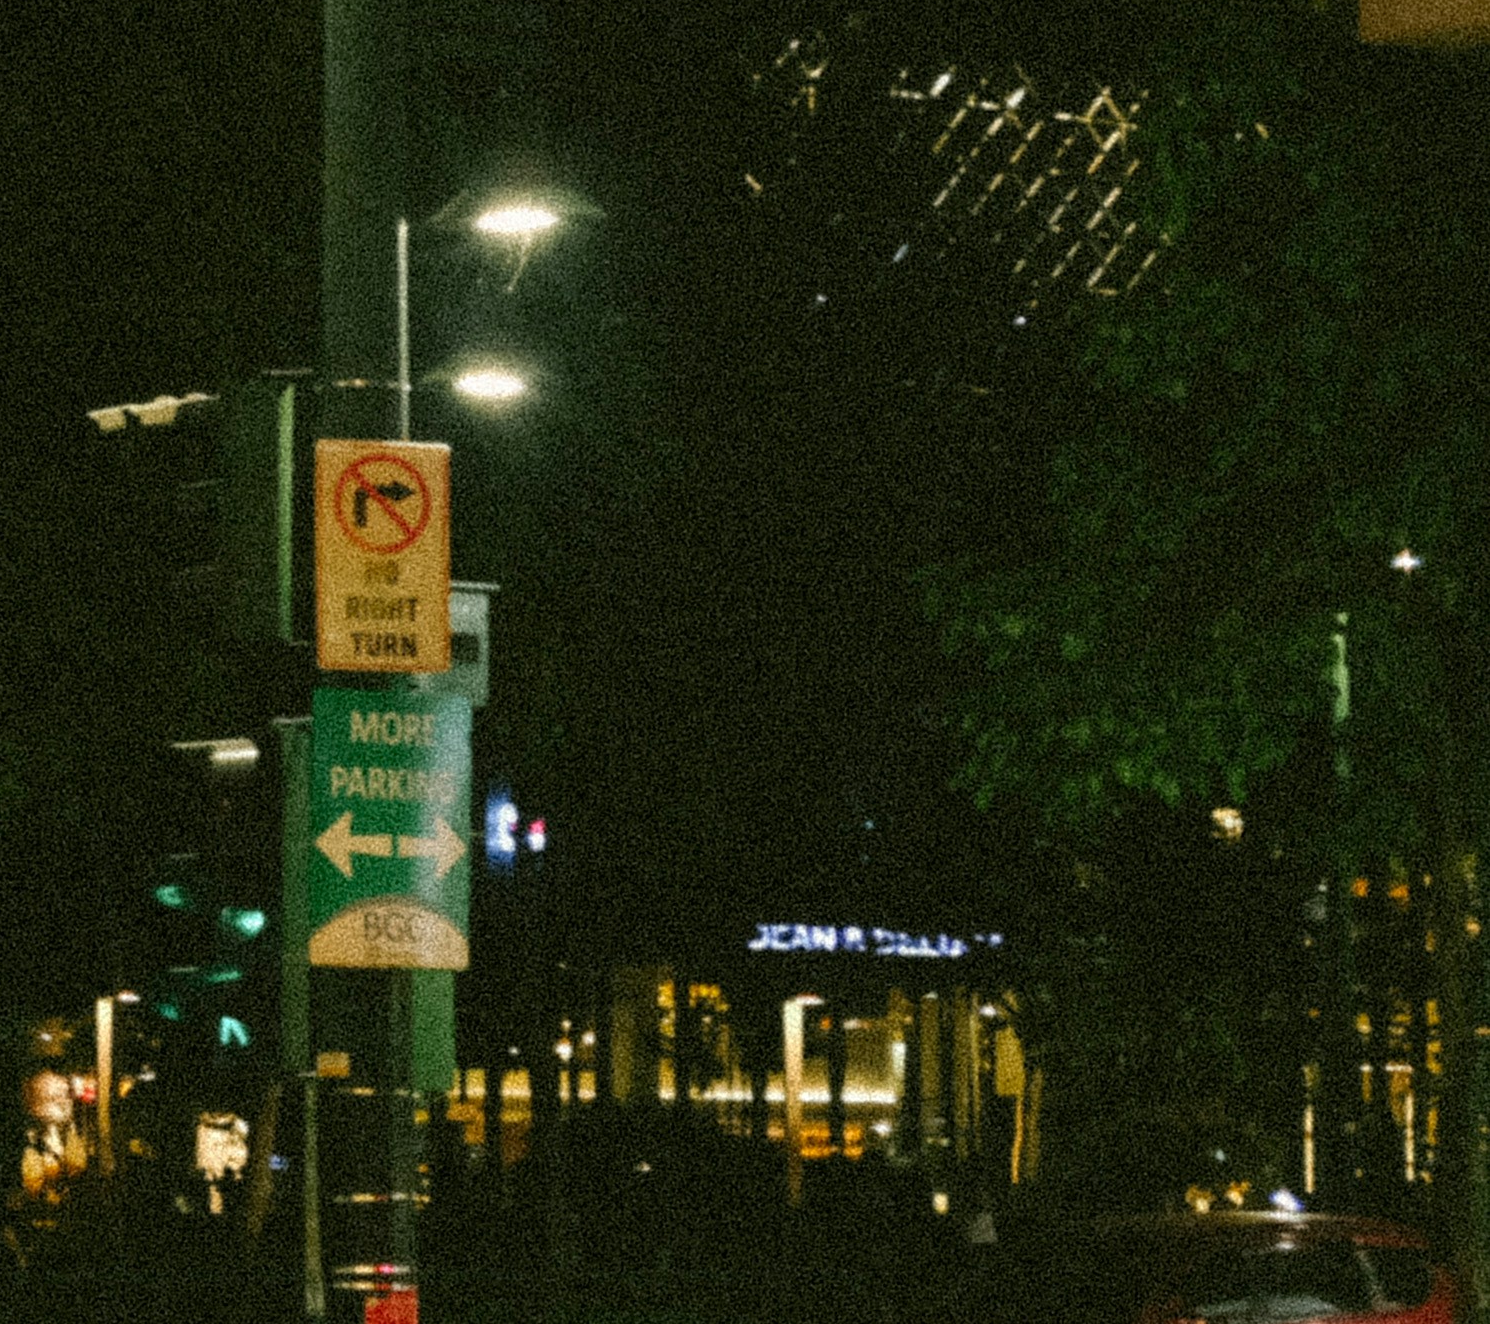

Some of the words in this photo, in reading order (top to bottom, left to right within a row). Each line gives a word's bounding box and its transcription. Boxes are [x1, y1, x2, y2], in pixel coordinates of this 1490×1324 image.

[345, 597, 419, 621] RIGHT
[350, 632, 418, 658] TURN
[349, 710, 436, 747] MORE
[329, 766, 456, 804] PARKING
[362, 911, 427, 942] BGC
